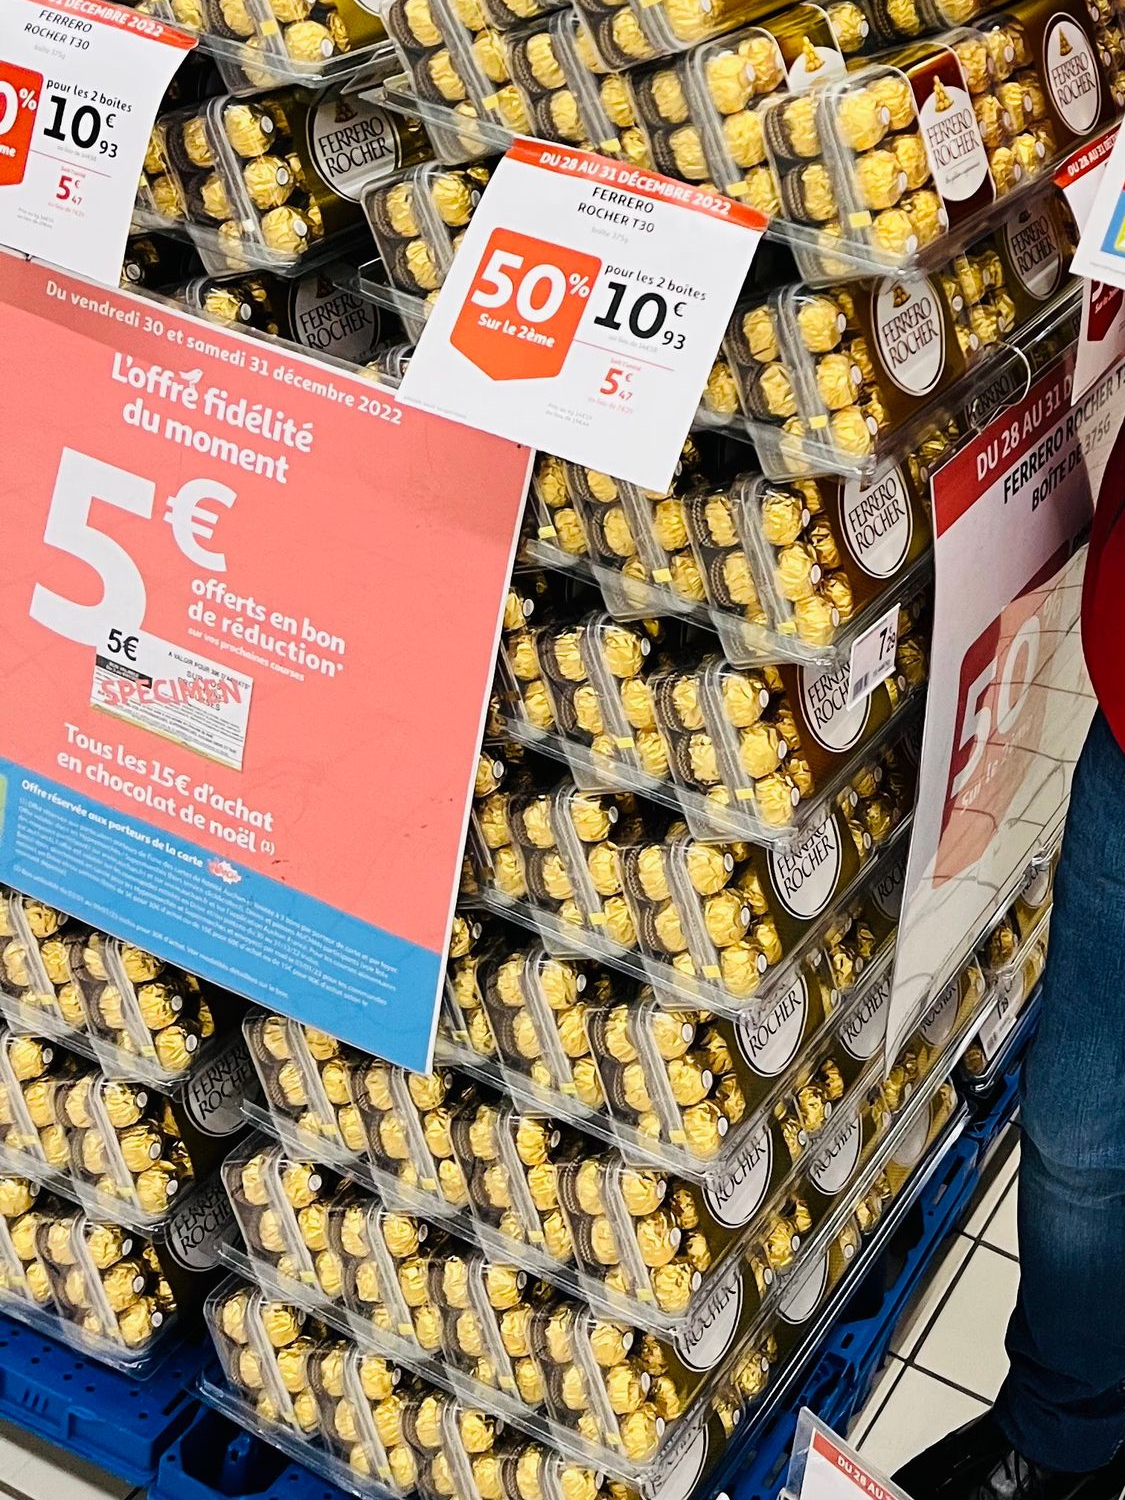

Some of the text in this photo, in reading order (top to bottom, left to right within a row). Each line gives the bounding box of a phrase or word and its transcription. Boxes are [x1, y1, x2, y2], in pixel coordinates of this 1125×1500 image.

[24, 23, 90, 51] ROCHER T30
[39, 9, 92, 33] FERRERO
[128, 13, 164, 38] 2022
[539, 151, 731, 216] DU 28 AU 31 DÉCEMBRE 2022
[592, 186, 655, 214] FERRERO
[577, 202, 656, 233] ROCHER T30
[605, 263, 707, 302] pour les 2 boîtes
[45, 279, 403, 425] Du vendredi 30 et samedi 31 décembre 2022
[477, 312, 555, 348] Sur le 2ème
[111, 353, 315, 454] L'offre fidélité
[122, 399, 289, 484] du moment
[976, 442, 998, 482] DU
[1000, 423, 1020, 459] 28
[1022, 402, 1044, 439] AU
[1045, 388, 1063, 421] 31
[1003, 423, 1064, 504] FERRERO
[1066, 384, 1115, 438] ROCHER
[1031, 415, 1111, 513] BOÎTE DE 375G
[848, 476, 897, 533] FERRERO
[855, 499, 905, 555] ROCHER
[107, 627, 139, 662] 5€
[188, 601, 217, 627] de
[191, 578, 346, 655] offerts en bon
[100, 678, 242, 707] SPECIMEN
[57, 749, 275, 855] en chocolat de noël (1)
[64, 722, 114, 761] Tous
[117, 744, 148, 775] les
[148, 760, 191, 797] 15€
[193, 777, 274, 834] d'achat
[21, 779, 204, 867] Offre réservée aux porteurs de la carte
[784, 835, 836, 900] ROCHER
[749, 989, 801, 1058] ROCHER
[837, 1454, 884, 1500] DU 28 AU
